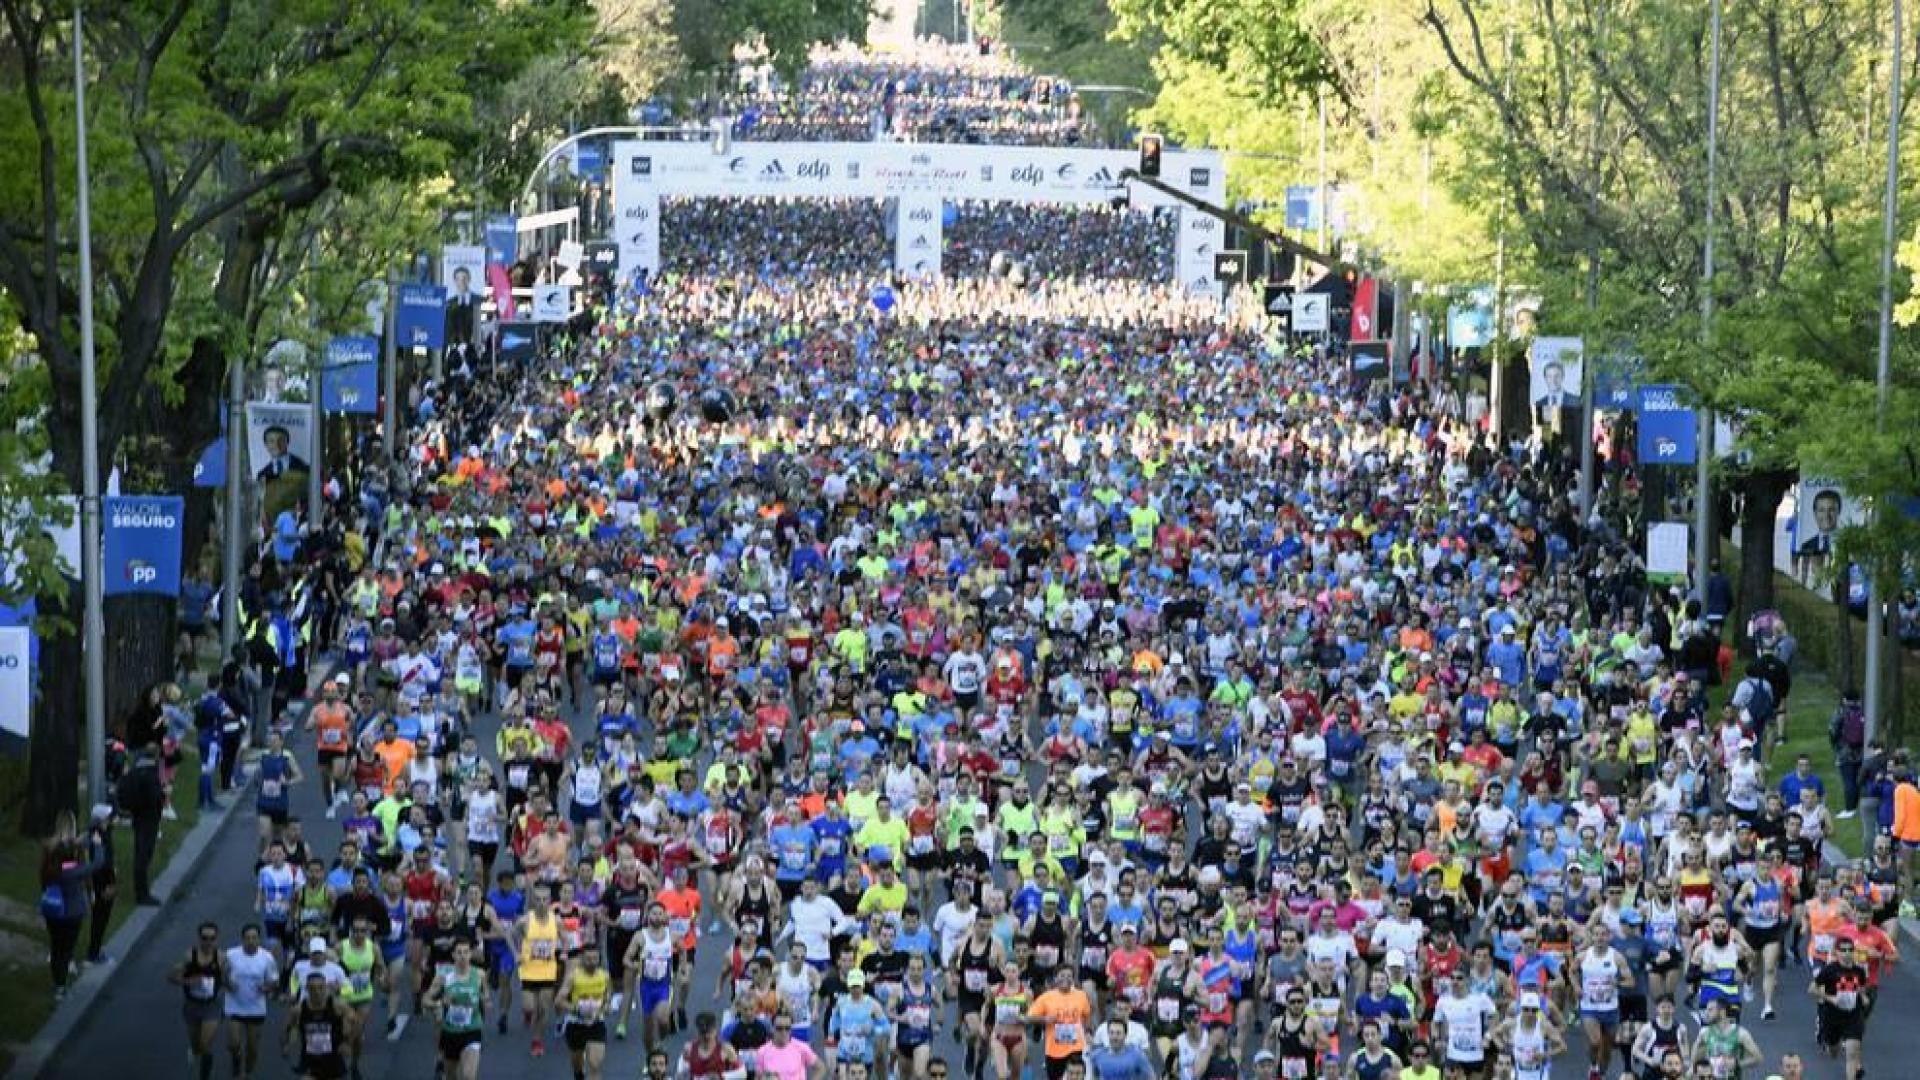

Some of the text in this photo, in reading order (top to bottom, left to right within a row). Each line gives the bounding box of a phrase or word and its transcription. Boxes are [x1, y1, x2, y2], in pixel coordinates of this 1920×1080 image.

[797, 158, 831, 181] edp
[1010, 163, 1044, 186] edp
[1659, 442, 1677, 457] pp
[112, 503, 162, 515] VALOR
[112, 514, 176, 528] SEGURO
[133, 567, 156, 585] pp
